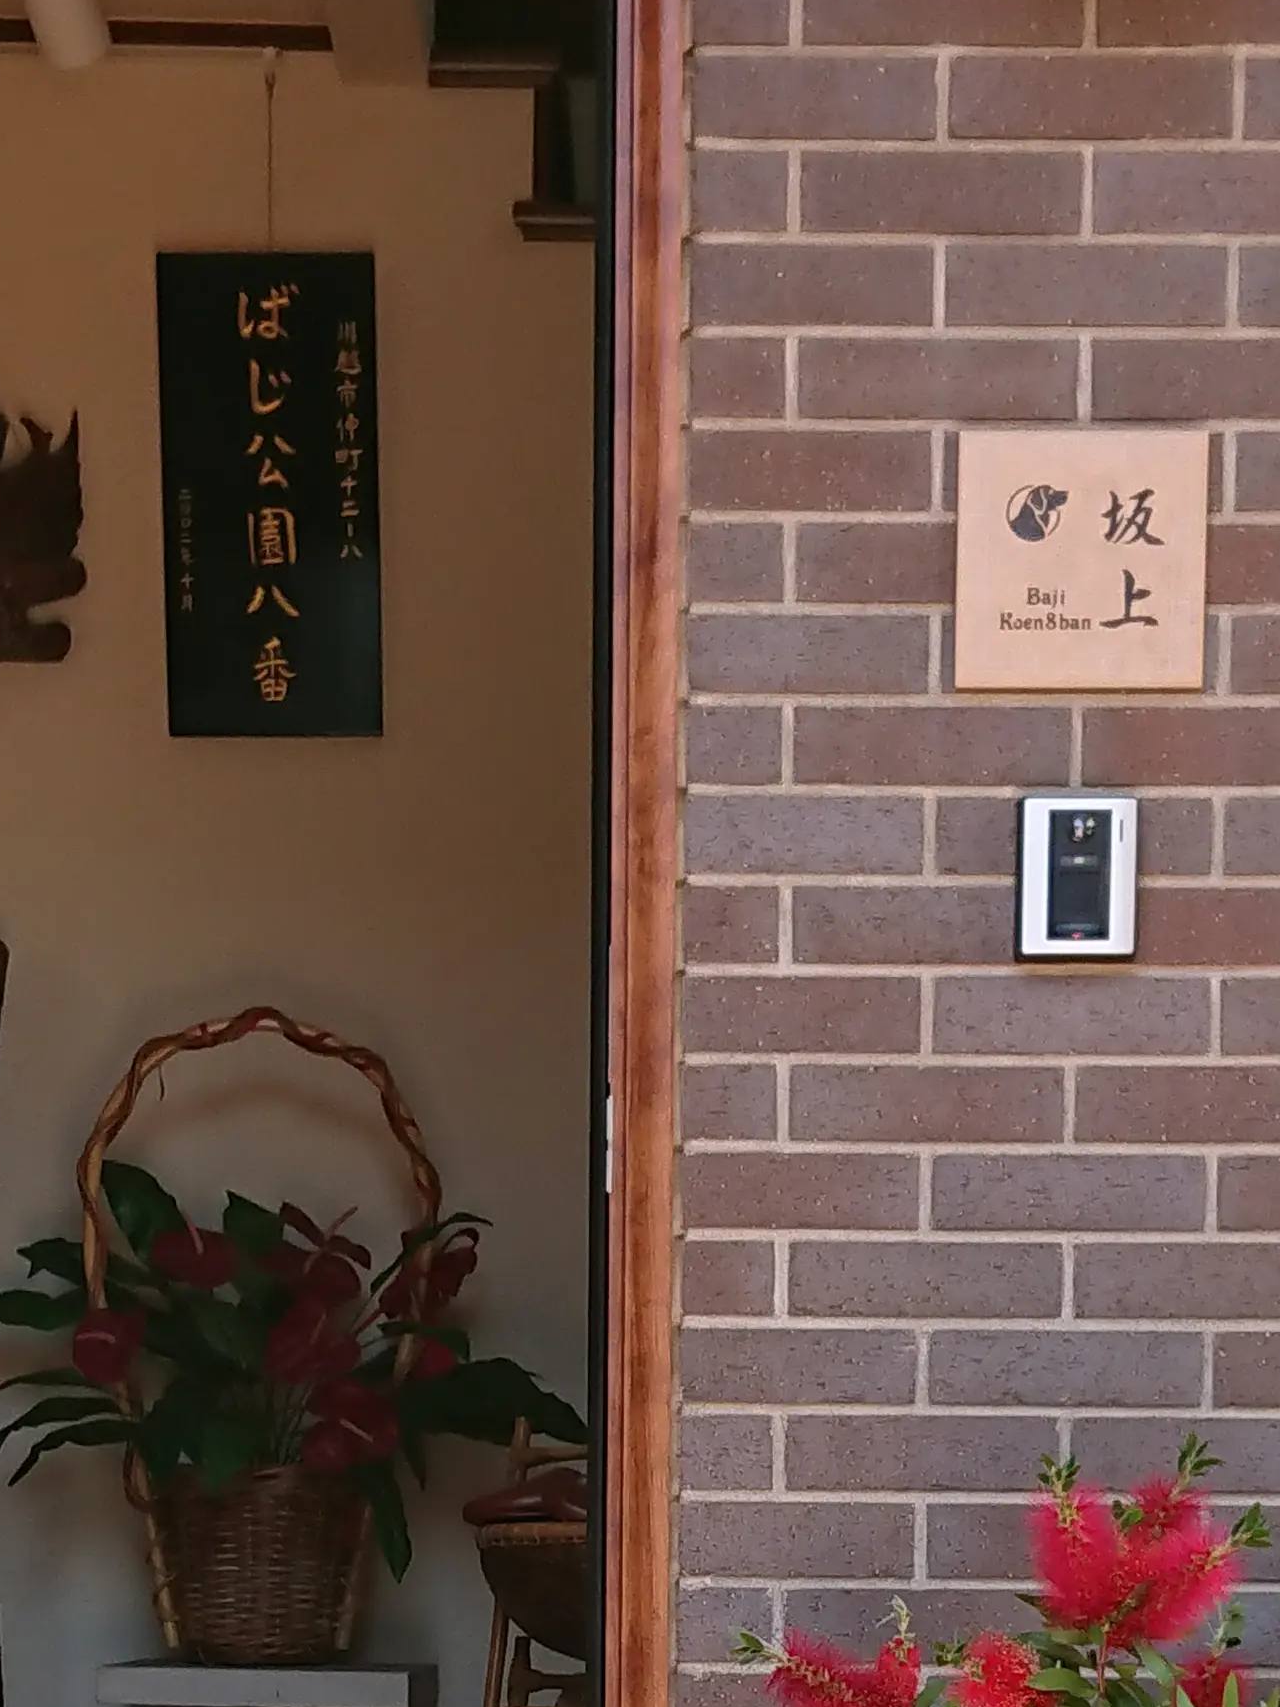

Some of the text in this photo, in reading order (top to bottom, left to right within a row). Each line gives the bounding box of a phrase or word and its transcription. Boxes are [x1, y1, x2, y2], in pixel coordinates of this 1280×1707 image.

[236, 282, 300, 703] ばじ公園八番
[1026, 587, 1066, 609] Baji
[1099, 488, 1166, 629] 坂上
[999, 612, 1092, 631] Koen8ban
